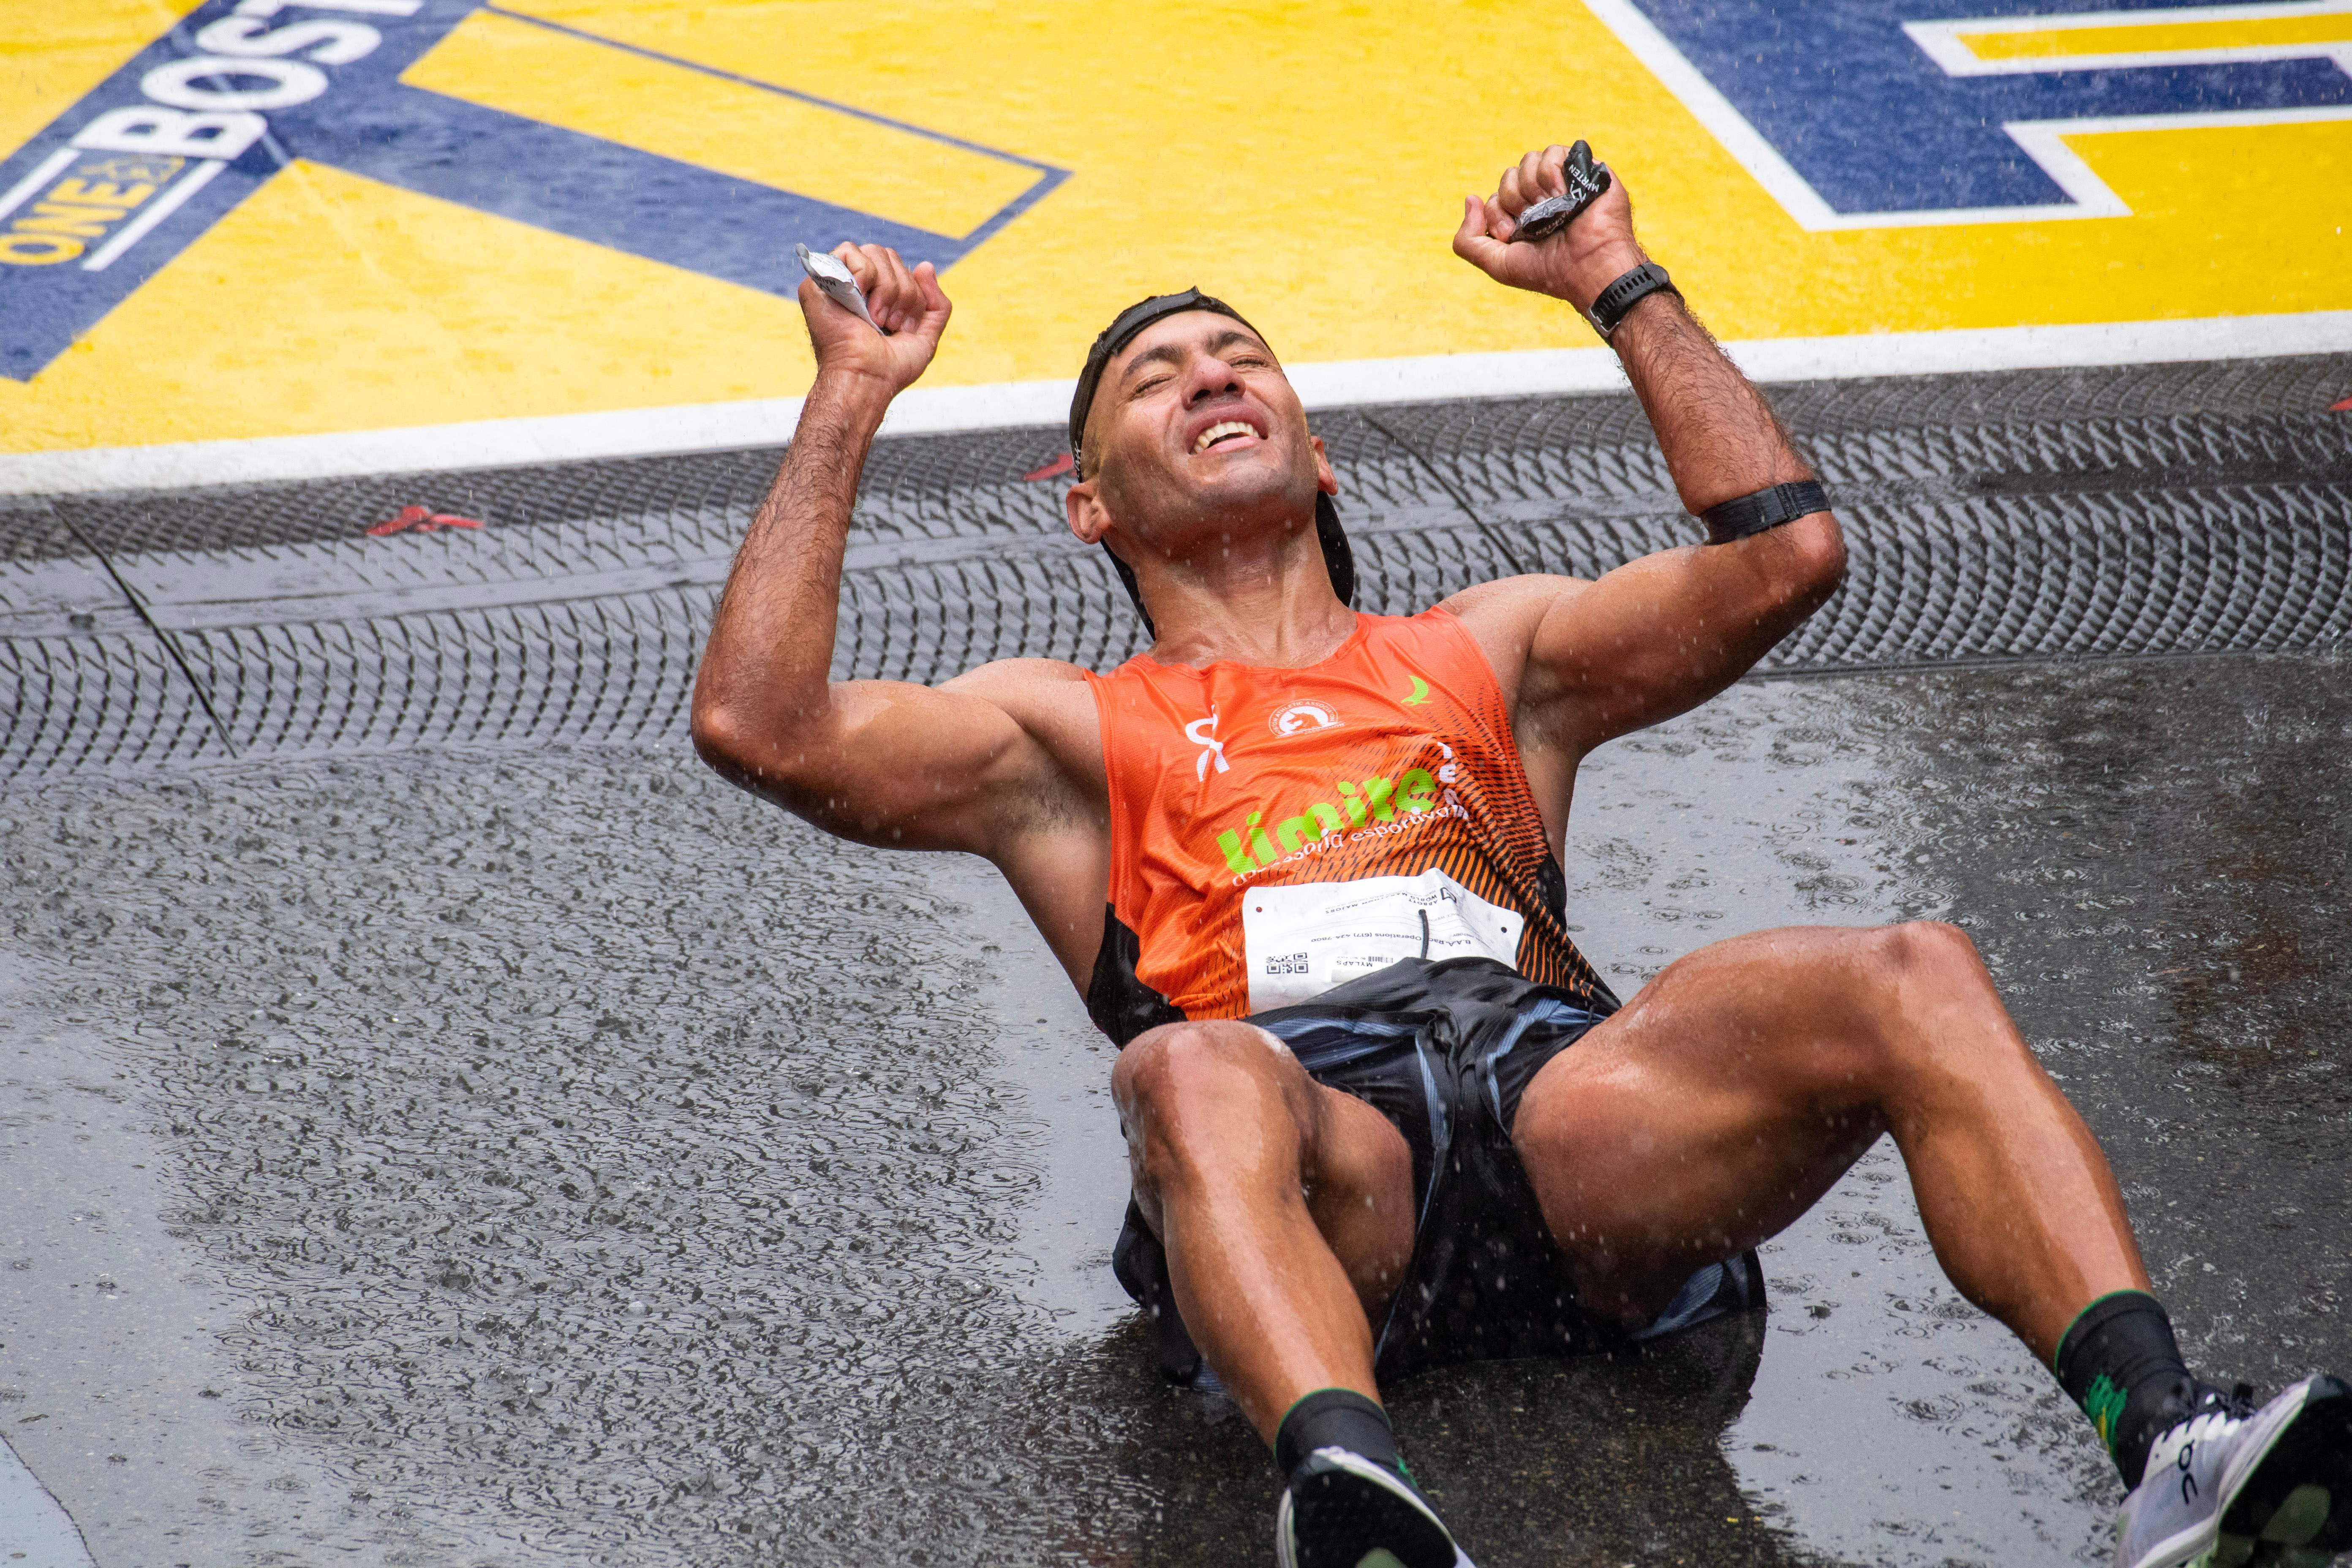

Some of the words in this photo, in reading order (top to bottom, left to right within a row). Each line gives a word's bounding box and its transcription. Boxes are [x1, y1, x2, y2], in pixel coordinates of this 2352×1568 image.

[0, 177, 159, 266] ONE
[1350, 806, 1450, 841] esportiva
[1375, 932, 1421, 941] Operations
